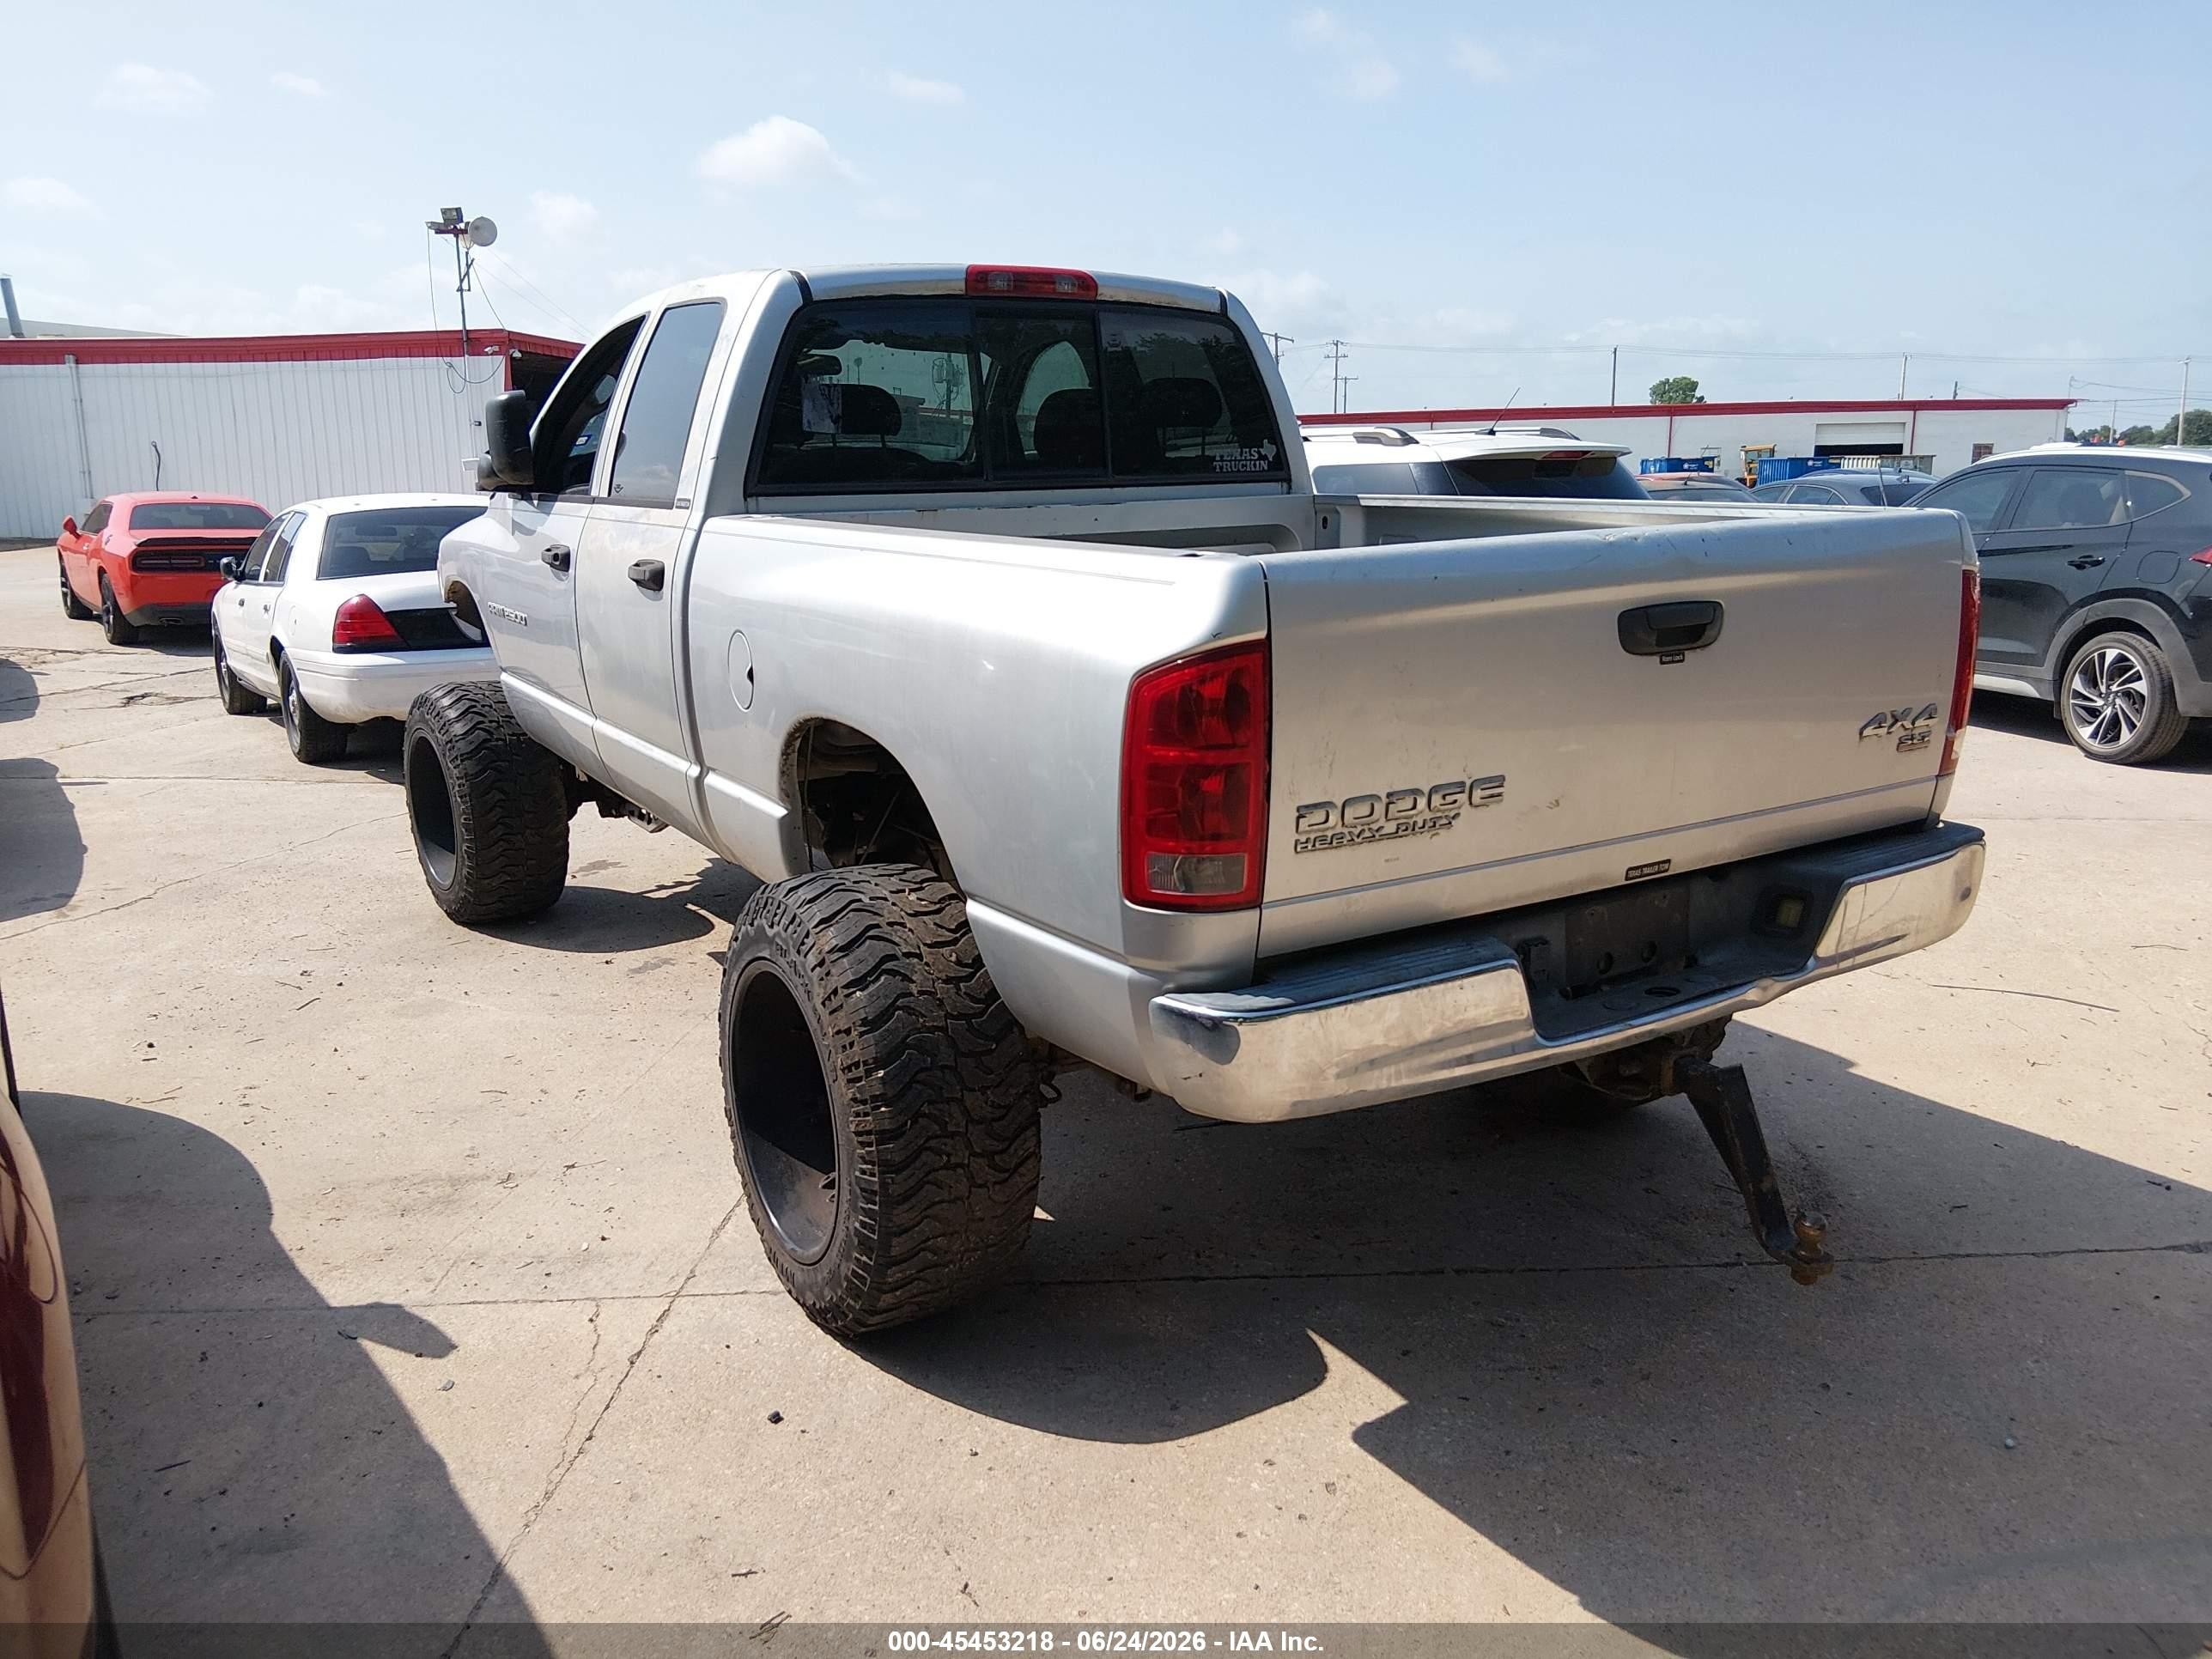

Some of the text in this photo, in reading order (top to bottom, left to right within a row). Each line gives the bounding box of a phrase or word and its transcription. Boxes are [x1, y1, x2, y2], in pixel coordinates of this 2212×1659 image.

[1212, 460, 1268, 472] TRUCKIN
[1215, 447, 1259, 461] TEXAS
[1859, 703, 1938, 739] 4X4
[1295, 774, 1506, 834] DODGE
[1294, 812, 1462, 854] HEAVY DUTY
